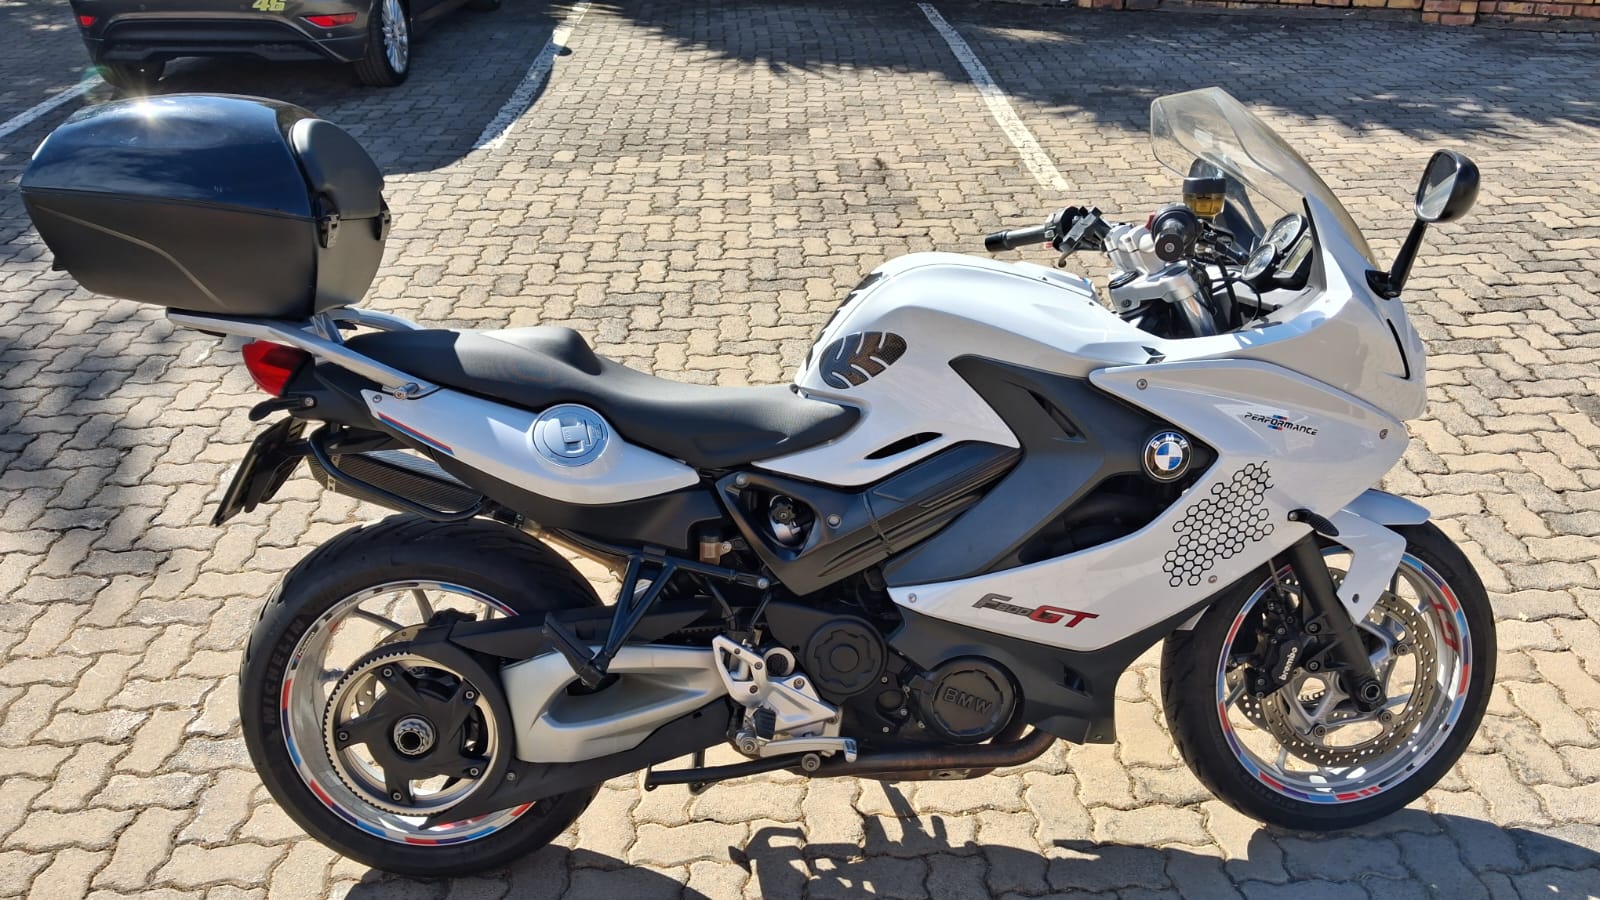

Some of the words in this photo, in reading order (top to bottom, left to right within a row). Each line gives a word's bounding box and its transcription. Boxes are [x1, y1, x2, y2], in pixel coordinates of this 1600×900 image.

[1244, 412, 1319, 436] PERFORMANCE
[1150, 433, 1189, 449] BMW
[263, 620, 306, 725] MICHELIN
[1278, 646, 1298, 681] brembo
[943, 687, 993, 715] BMW
